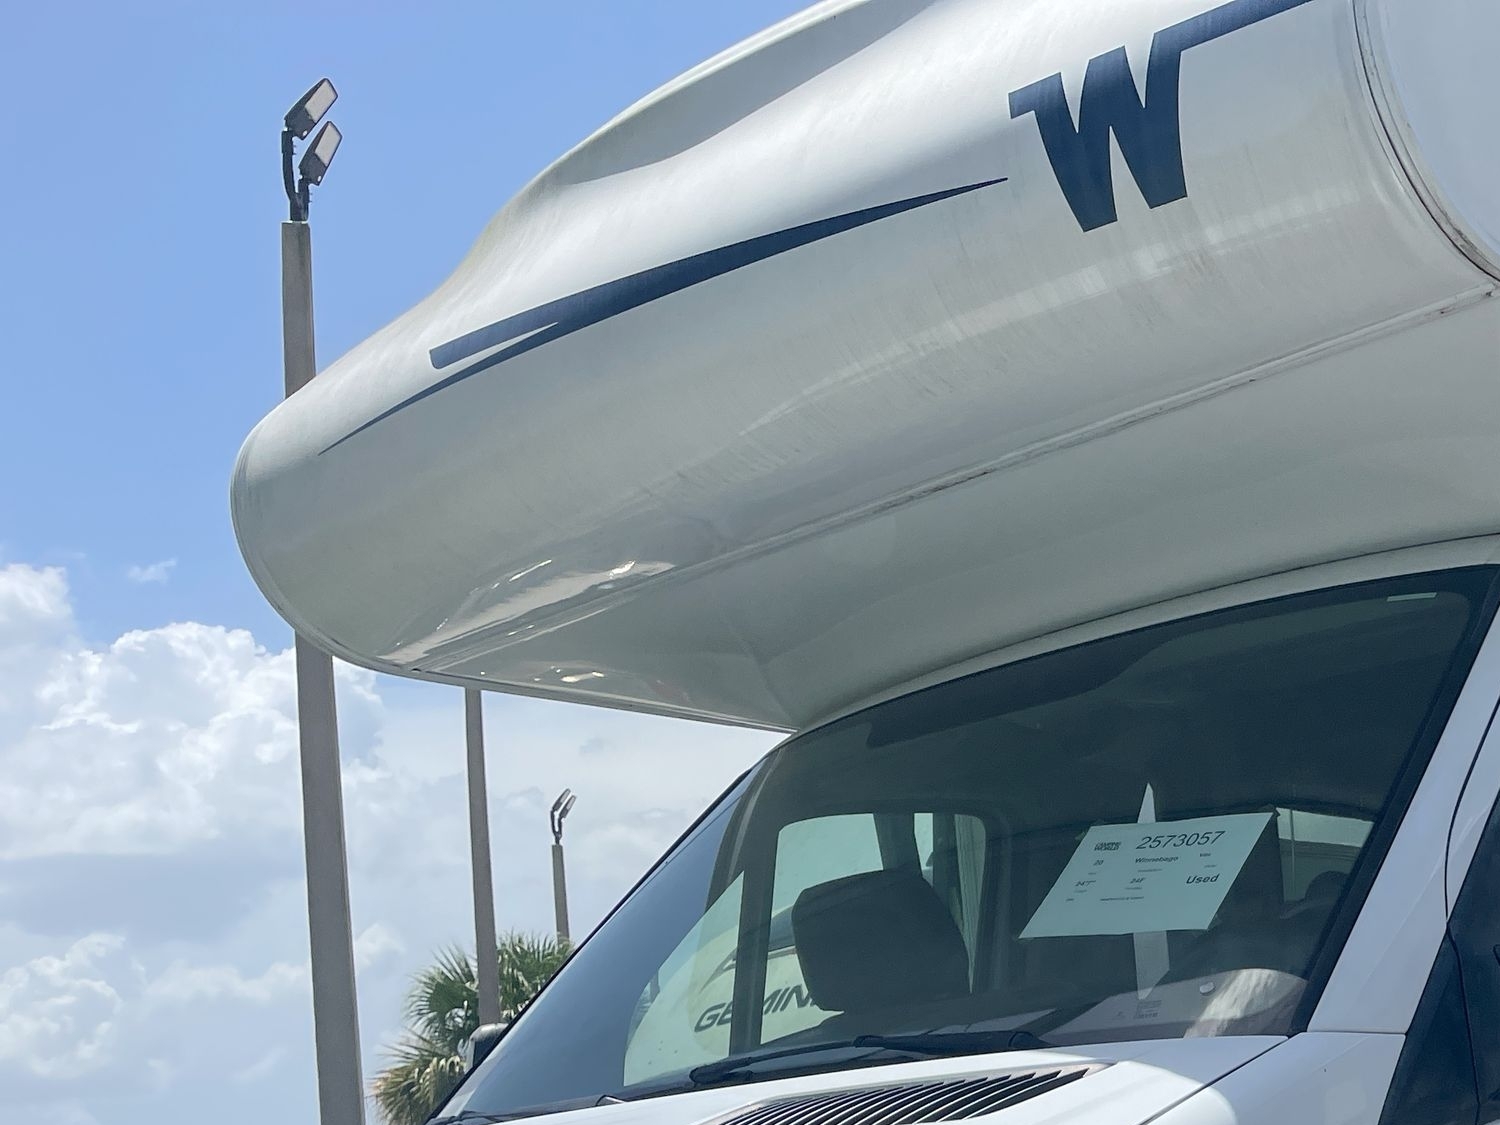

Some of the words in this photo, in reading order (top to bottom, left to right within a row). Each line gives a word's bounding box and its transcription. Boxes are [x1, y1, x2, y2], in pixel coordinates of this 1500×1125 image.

[1135, 831, 1226, 849] 2573057
[1135, 856, 1179, 864] Winnebago
[1186, 874, 1220, 884] Used
[694, 984, 818, 1033] GEMIN
